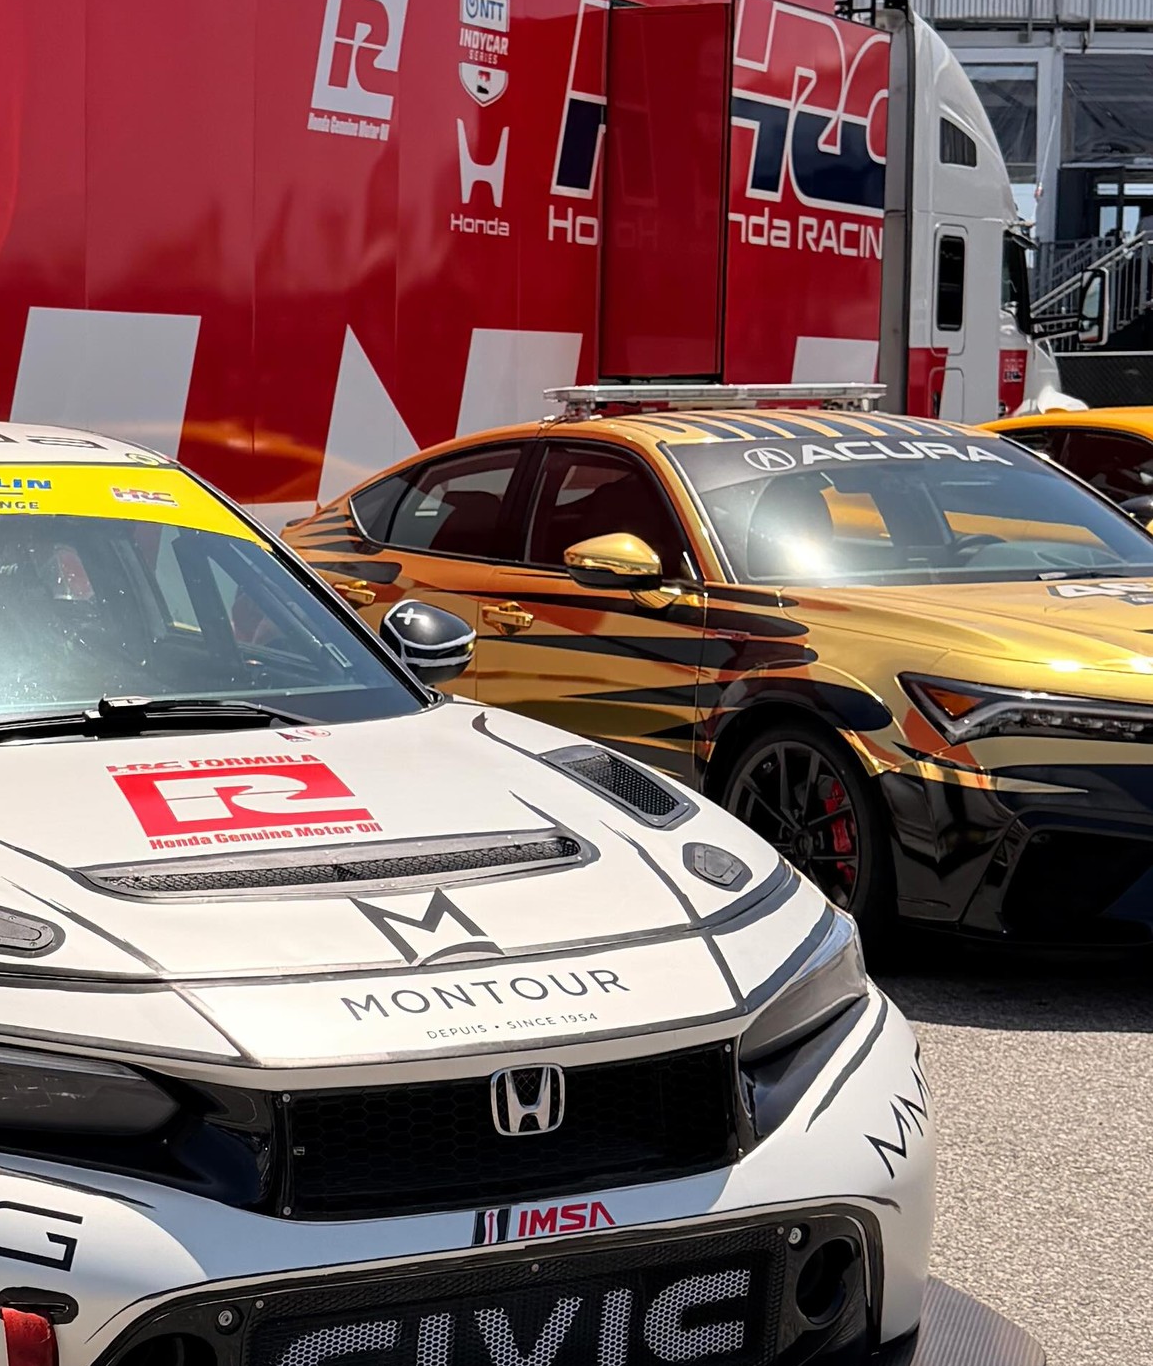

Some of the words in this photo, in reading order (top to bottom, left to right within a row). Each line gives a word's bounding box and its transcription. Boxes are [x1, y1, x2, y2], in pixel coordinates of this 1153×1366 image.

[459, 28, 509, 56] INDYCAR
[469, 49, 498, 65] SERIES
[450, 213, 510, 236] Honda
[798, 215, 884, 260] RACIN
[802, 440, 1014, 466] ACURA
[112, 487, 175, 503] HRC
[106, 762, 185, 773] HRC
[189, 754, 321, 768] FORMULA
[149, 835, 213, 850] Honda
[216, 829, 293, 844] Genuine
[293, 825, 355, 838] Motor
[359, 822, 384, 833] Oil
[340, 969, 631, 1021] MONTOUR
[426, 1025, 488, 1040] DEPUIS
[507, 1016, 557, 1030] SINCE
[560, 1012, 598, 1024] 1954
[864, 1039, 934, 1179] MM
[518, 1202, 617, 1237] IMSA
